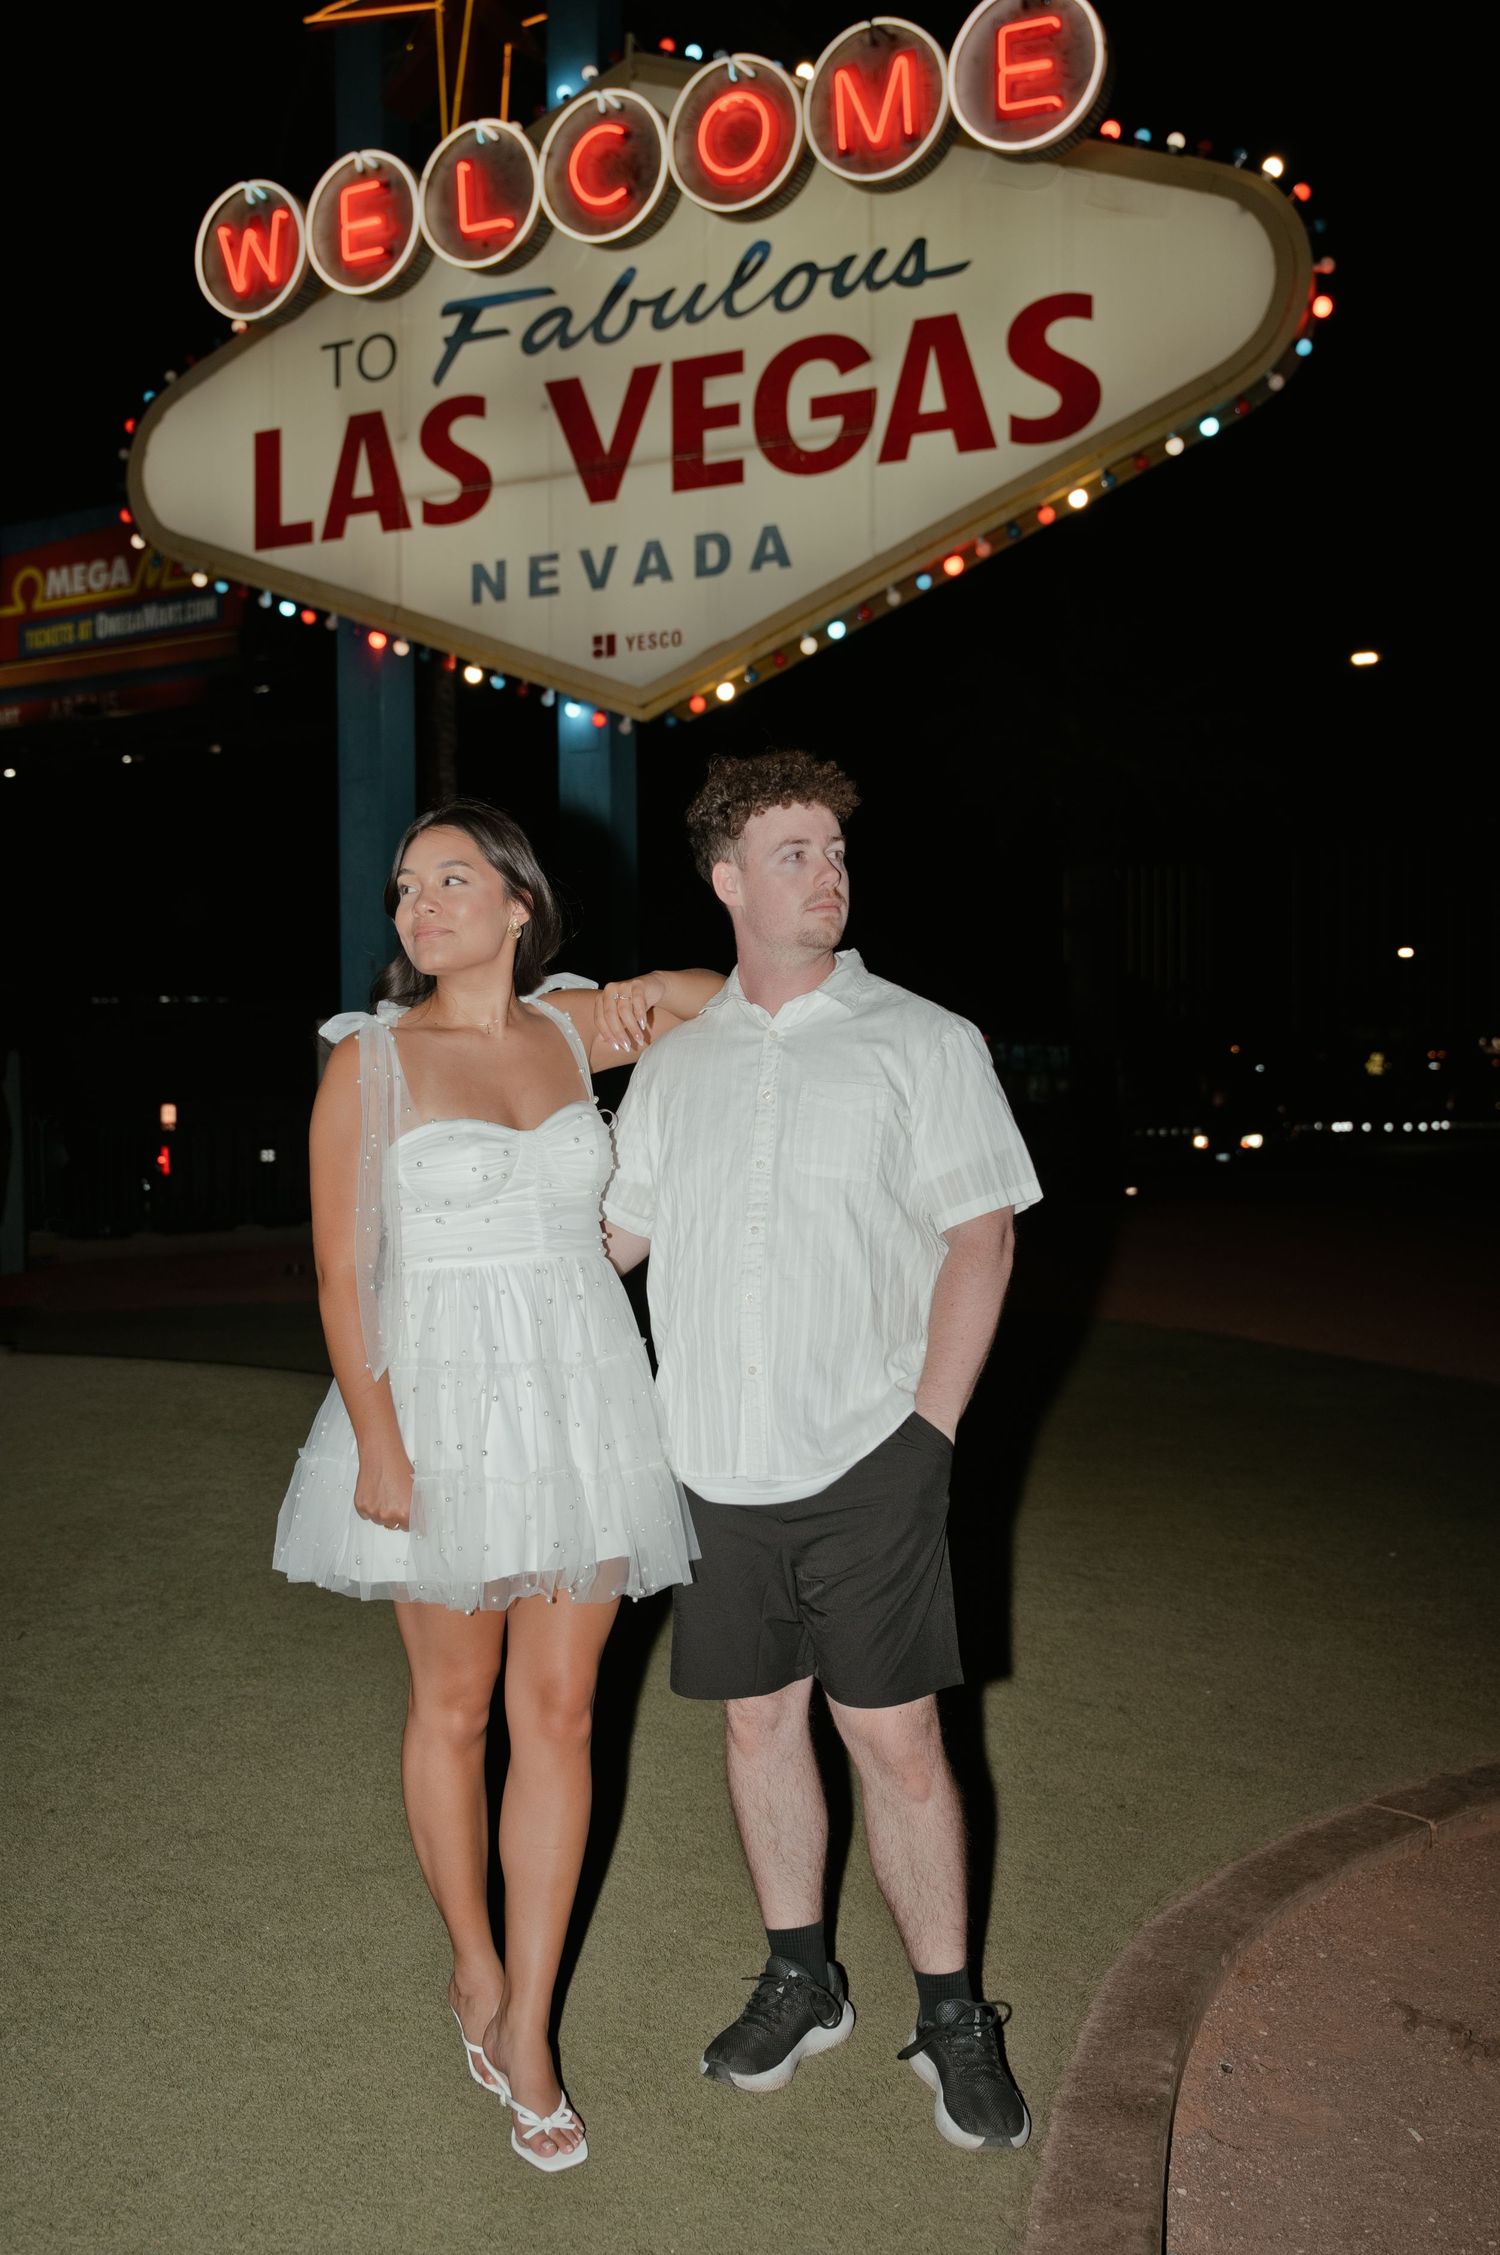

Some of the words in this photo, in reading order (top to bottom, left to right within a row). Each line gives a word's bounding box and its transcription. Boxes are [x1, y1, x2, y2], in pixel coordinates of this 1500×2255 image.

[216, 13, 1064, 294] WELCOME
[320, 333, 398, 389] TO
[432, 237, 973, 387] Fabulous
[254, 394, 493, 552] LAS
[544, 292, 1103, 505] VEGAS
[471, 524, 792, 605] NEVADA
[625, 629, 683, 651] YESCO
